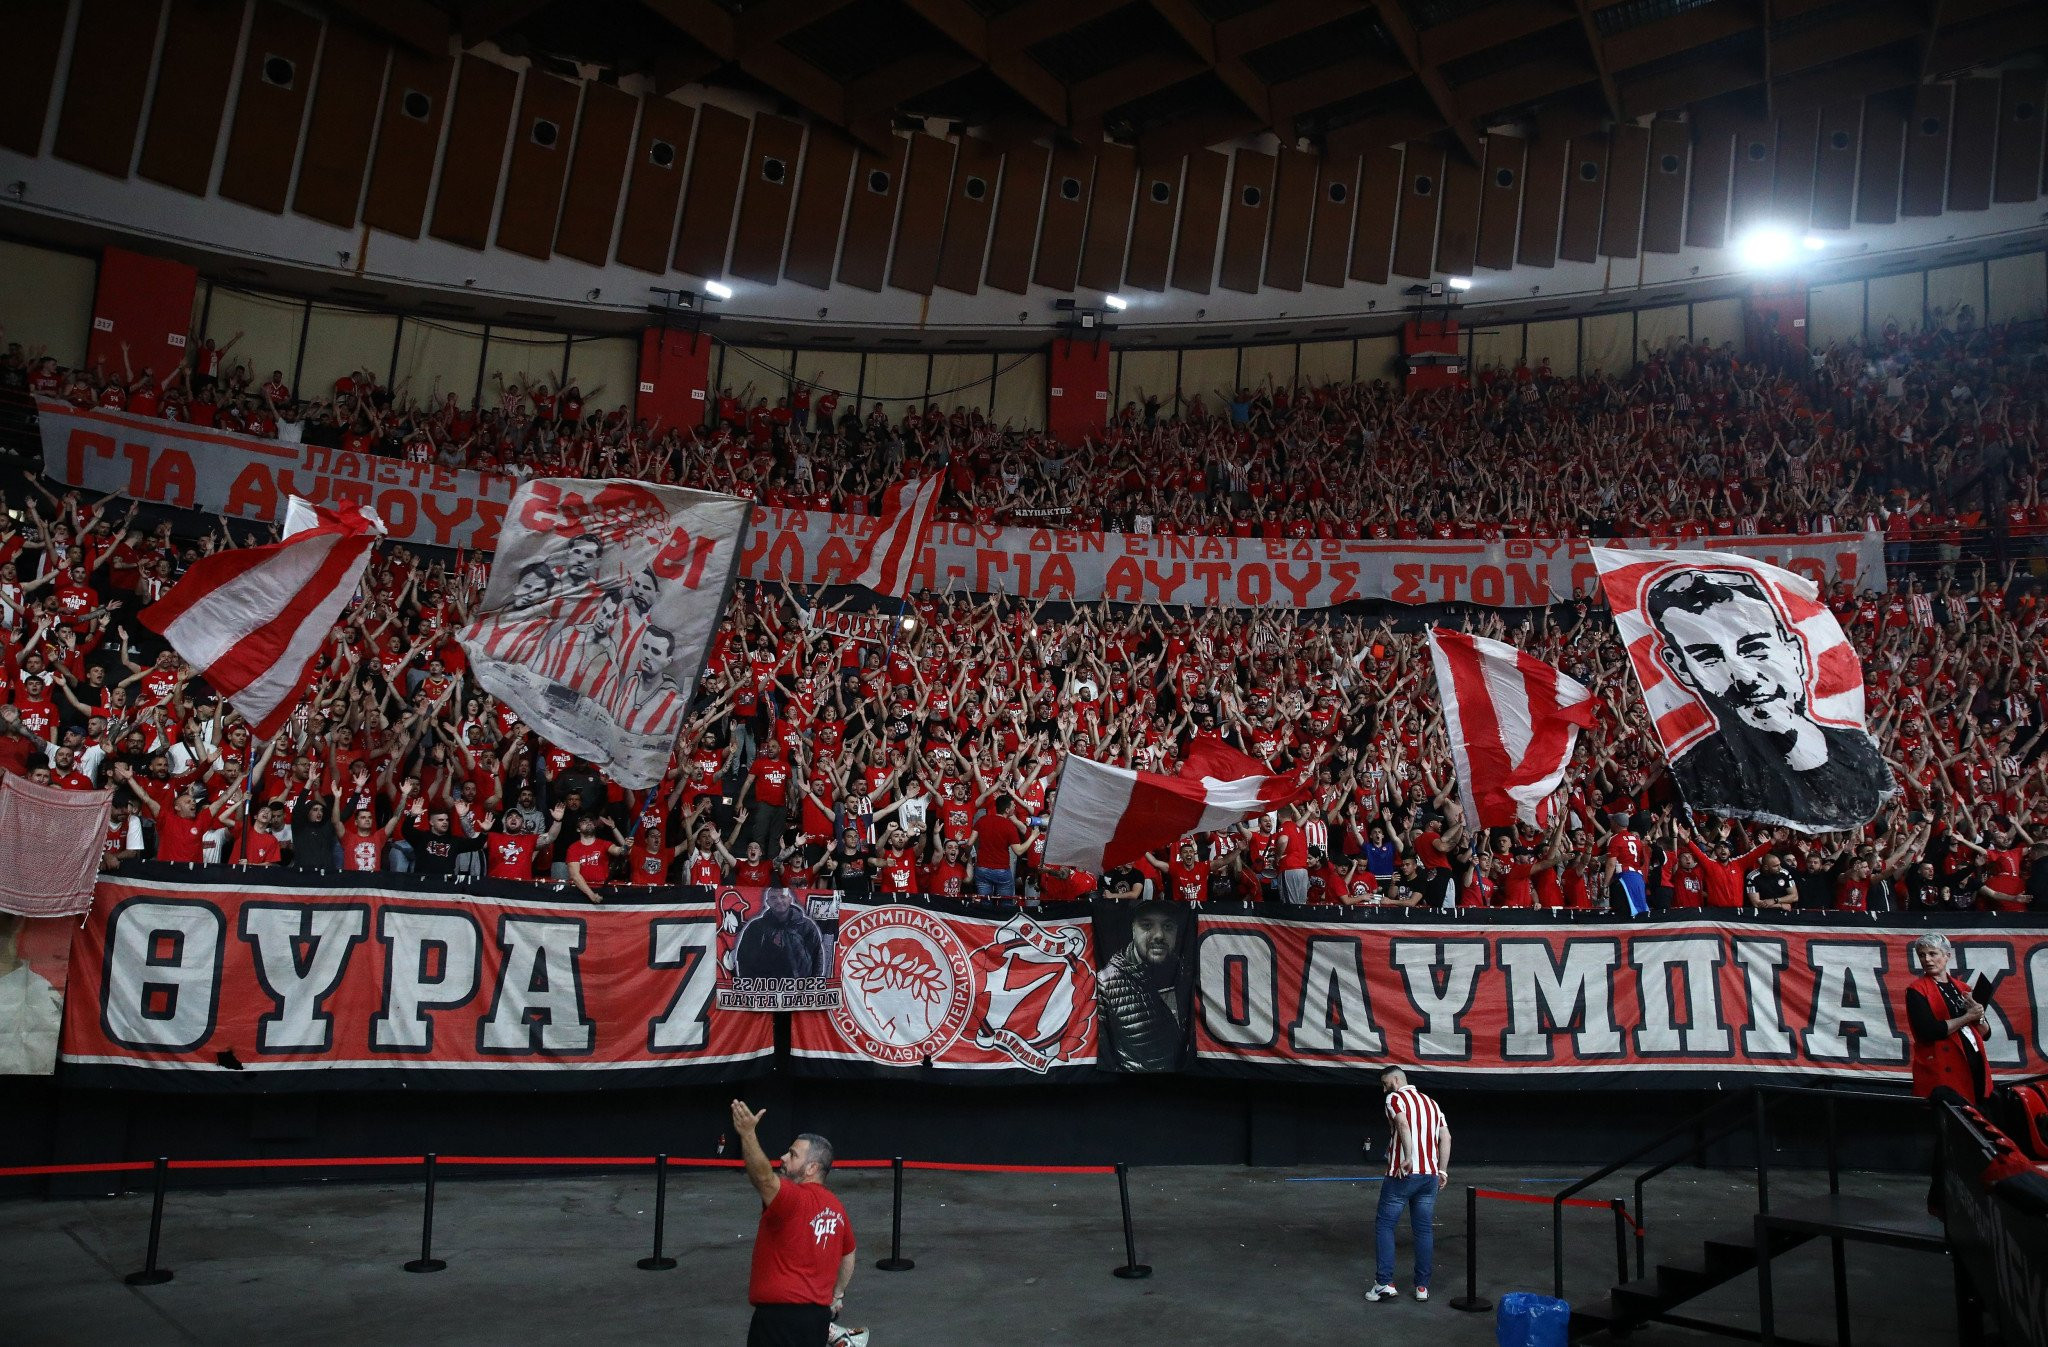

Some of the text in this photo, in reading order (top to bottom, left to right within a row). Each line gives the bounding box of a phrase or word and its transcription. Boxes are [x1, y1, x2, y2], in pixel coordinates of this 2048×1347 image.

[97, 320, 111, 328] 317
[66, 428, 197, 508] ΓΙΑ
[1106, 555, 1361, 608] ΑΥΤΟΥΣ
[1392, 562, 1550, 606] ΣΤΟΝ
[1014, 502, 1072, 516] ΝΑΥΠΑΚΤΟΣ
[827, 513, 879, 537] ΜΑ
[1030, 528, 1105, 553] ΔΕΝ
[1122, 532, 1240, 560] ΕΙΝΑΙ
[701, 866, 711, 876] 14
[847, 910, 952, 947] ΟΛΥΜΠΙΑΚΟΣ
[1019, 922, 1067, 955] GATE
[104, 896, 593, 1054] ΘΥΡΑ
[646, 915, 718, 1052] 7
[733, 977, 828, 992] 22/10/2022
[944, 950, 970, 1030] ΠΕΙΡΑΙΩΣ
[720, 990, 840, 1009] ΠΑΝΤΑ ΠΑΡΩΝ
[1200, 928, 2048, 1065] ΟΛΥΜΠΙΑΚ
[865, 1030, 948, 1061] ΦΙΛΑΘΛΩΝ
